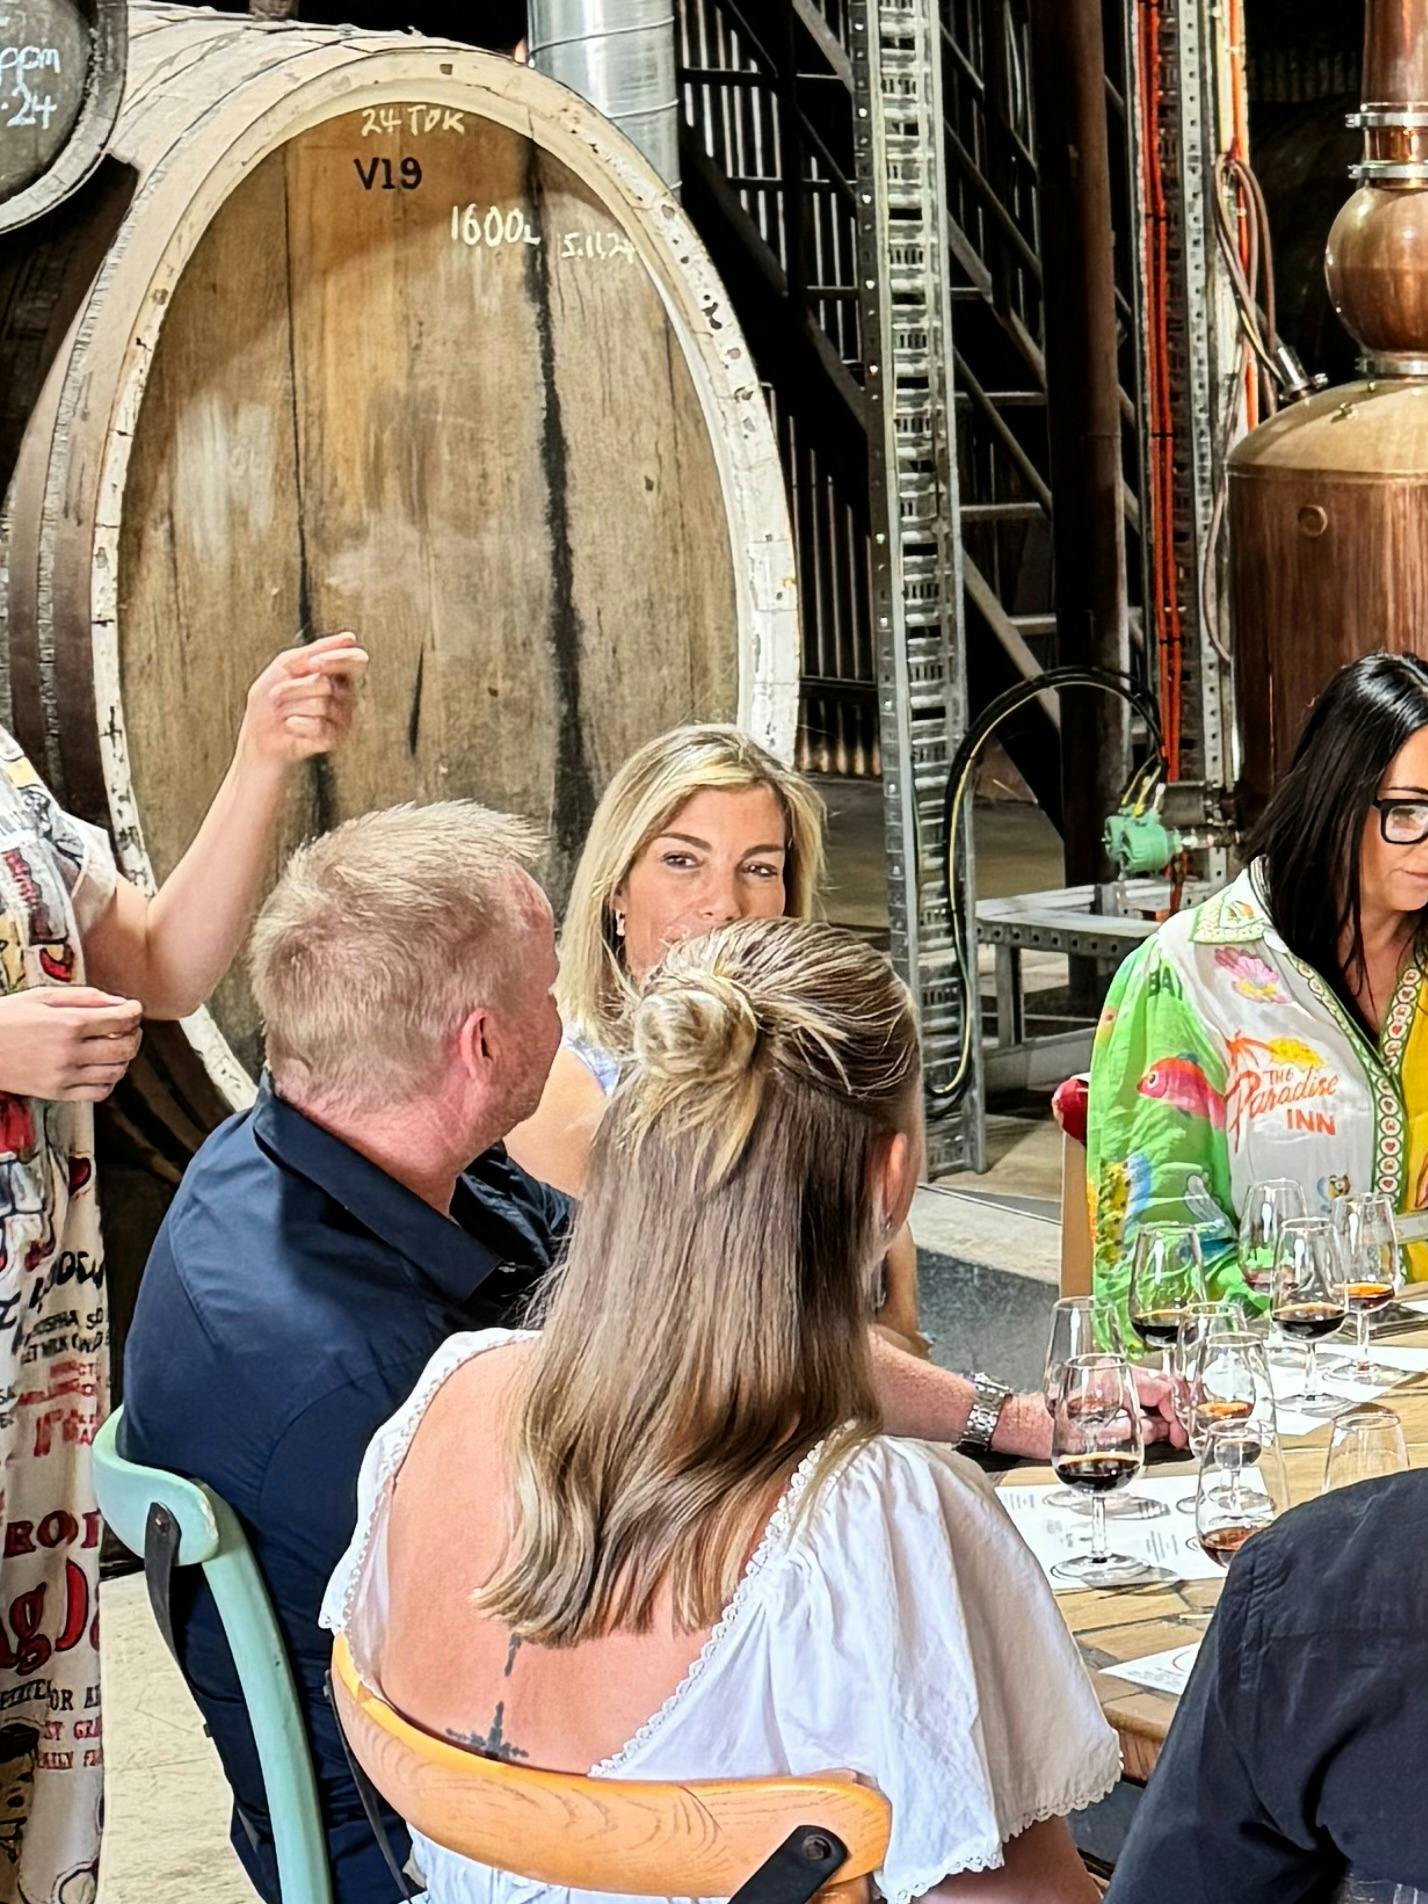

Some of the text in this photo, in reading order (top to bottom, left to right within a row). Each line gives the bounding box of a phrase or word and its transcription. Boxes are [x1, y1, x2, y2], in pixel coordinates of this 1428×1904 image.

[361, 108, 402, 137] 24
[353, 156, 423, 190] V19
[451, 202, 542, 247] 1600L
[1262, 1067, 1295, 1086] THE
[1224, 1063, 1340, 1154] Paradise
[1286, 1108, 1337, 1136] INN
